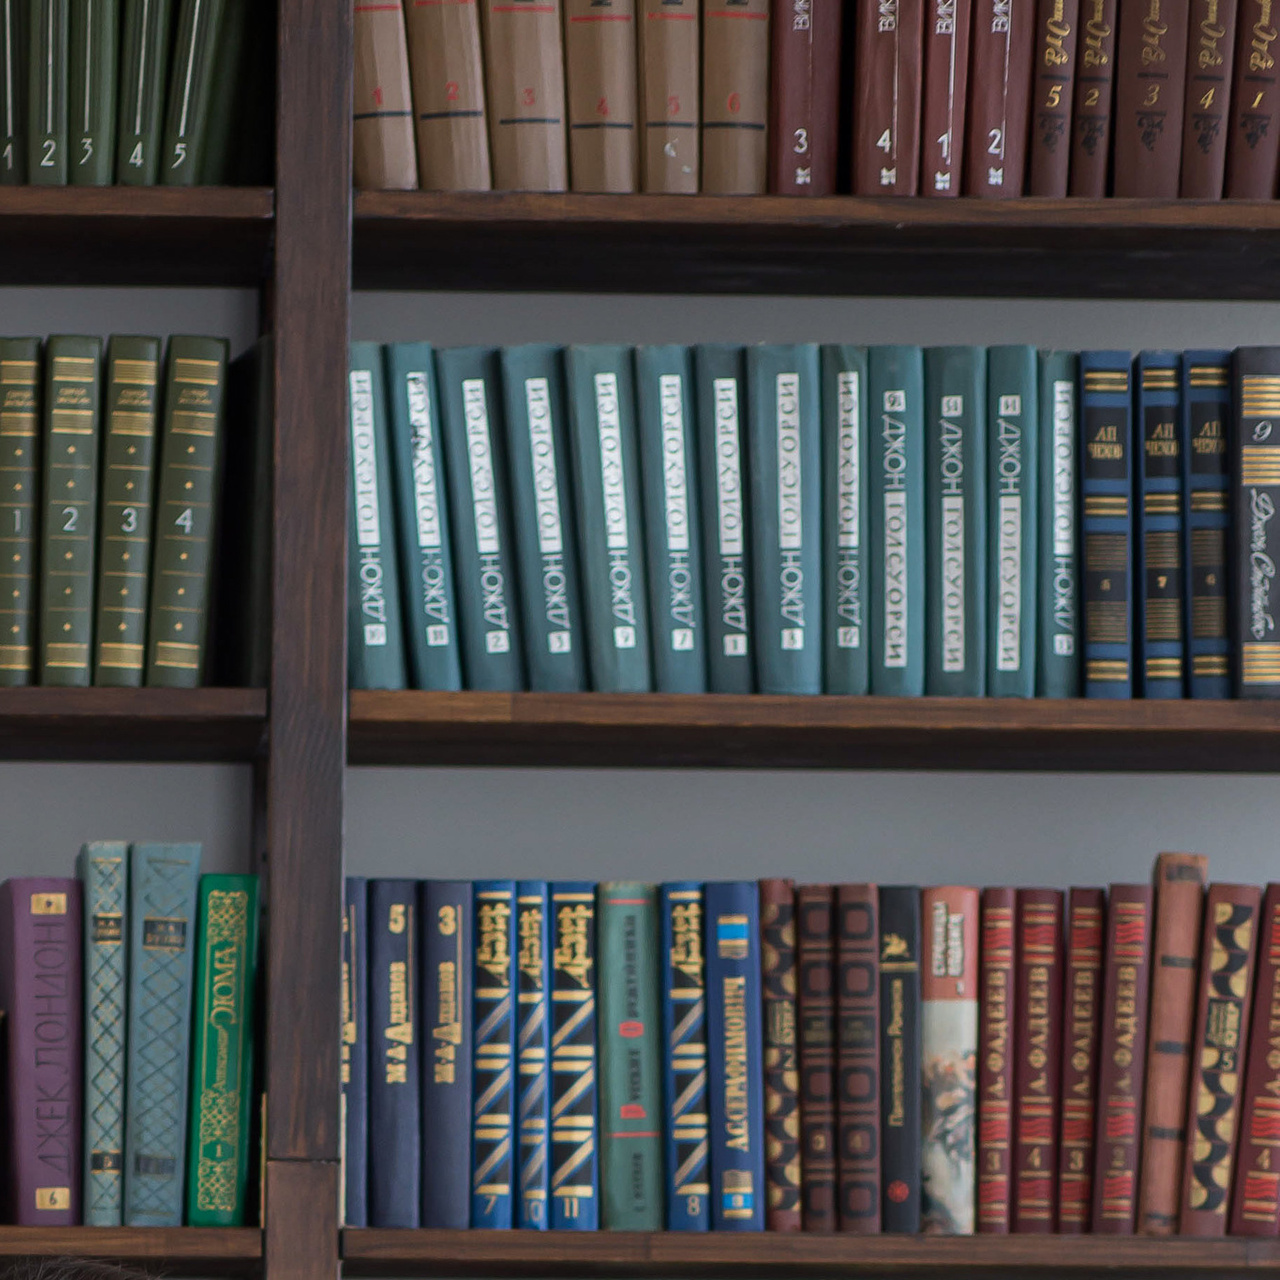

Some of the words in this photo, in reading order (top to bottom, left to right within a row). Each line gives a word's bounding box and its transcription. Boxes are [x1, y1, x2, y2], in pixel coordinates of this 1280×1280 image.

[1046, 84, 1063, 109] 5
[1199, 87, 1215, 110] 4
[40, 139, 56, 167] 2
[793, 128, 808, 154] 3
[876, 129, 891, 153] 4
[987, 129, 1001, 154] 2
[130, 143, 143, 168] 4
[172, 143, 187, 169] 5
[62, 508, 78, 533] 2
[175, 508, 193, 534] 4
[480, 555, 510, 629] ДЖОН
[721, 556, 747, 631] ДЖОН
[780, 551, 805, 627] ДЖОН
[390, 905, 405, 933] 5
[438, 905, 456, 935] 3
[33, 921, 68, 1083] ЛОНДОН
[35, 1104, 71, 1175] ДЖЕК
